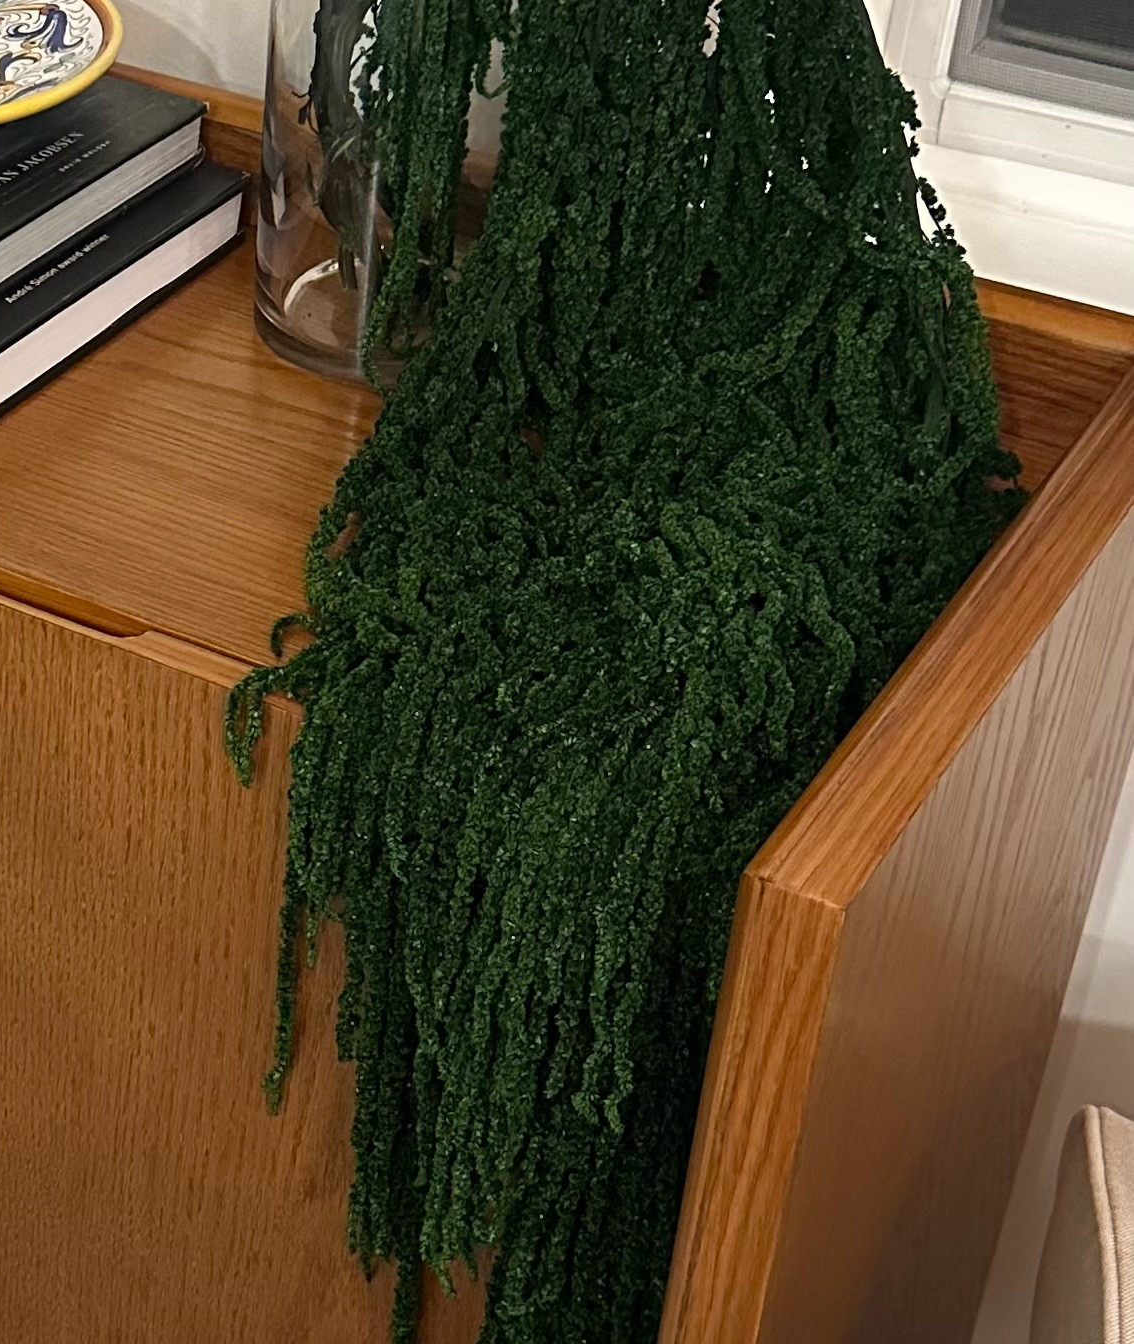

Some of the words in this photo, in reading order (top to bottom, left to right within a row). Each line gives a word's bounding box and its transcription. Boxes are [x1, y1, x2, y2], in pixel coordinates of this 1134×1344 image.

[17, 131, 84, 172] JACOBSEN
[29, 267, 60, 287] Simon
[57, 251, 84, 269] award
[82, 234, 110, 252] winner
